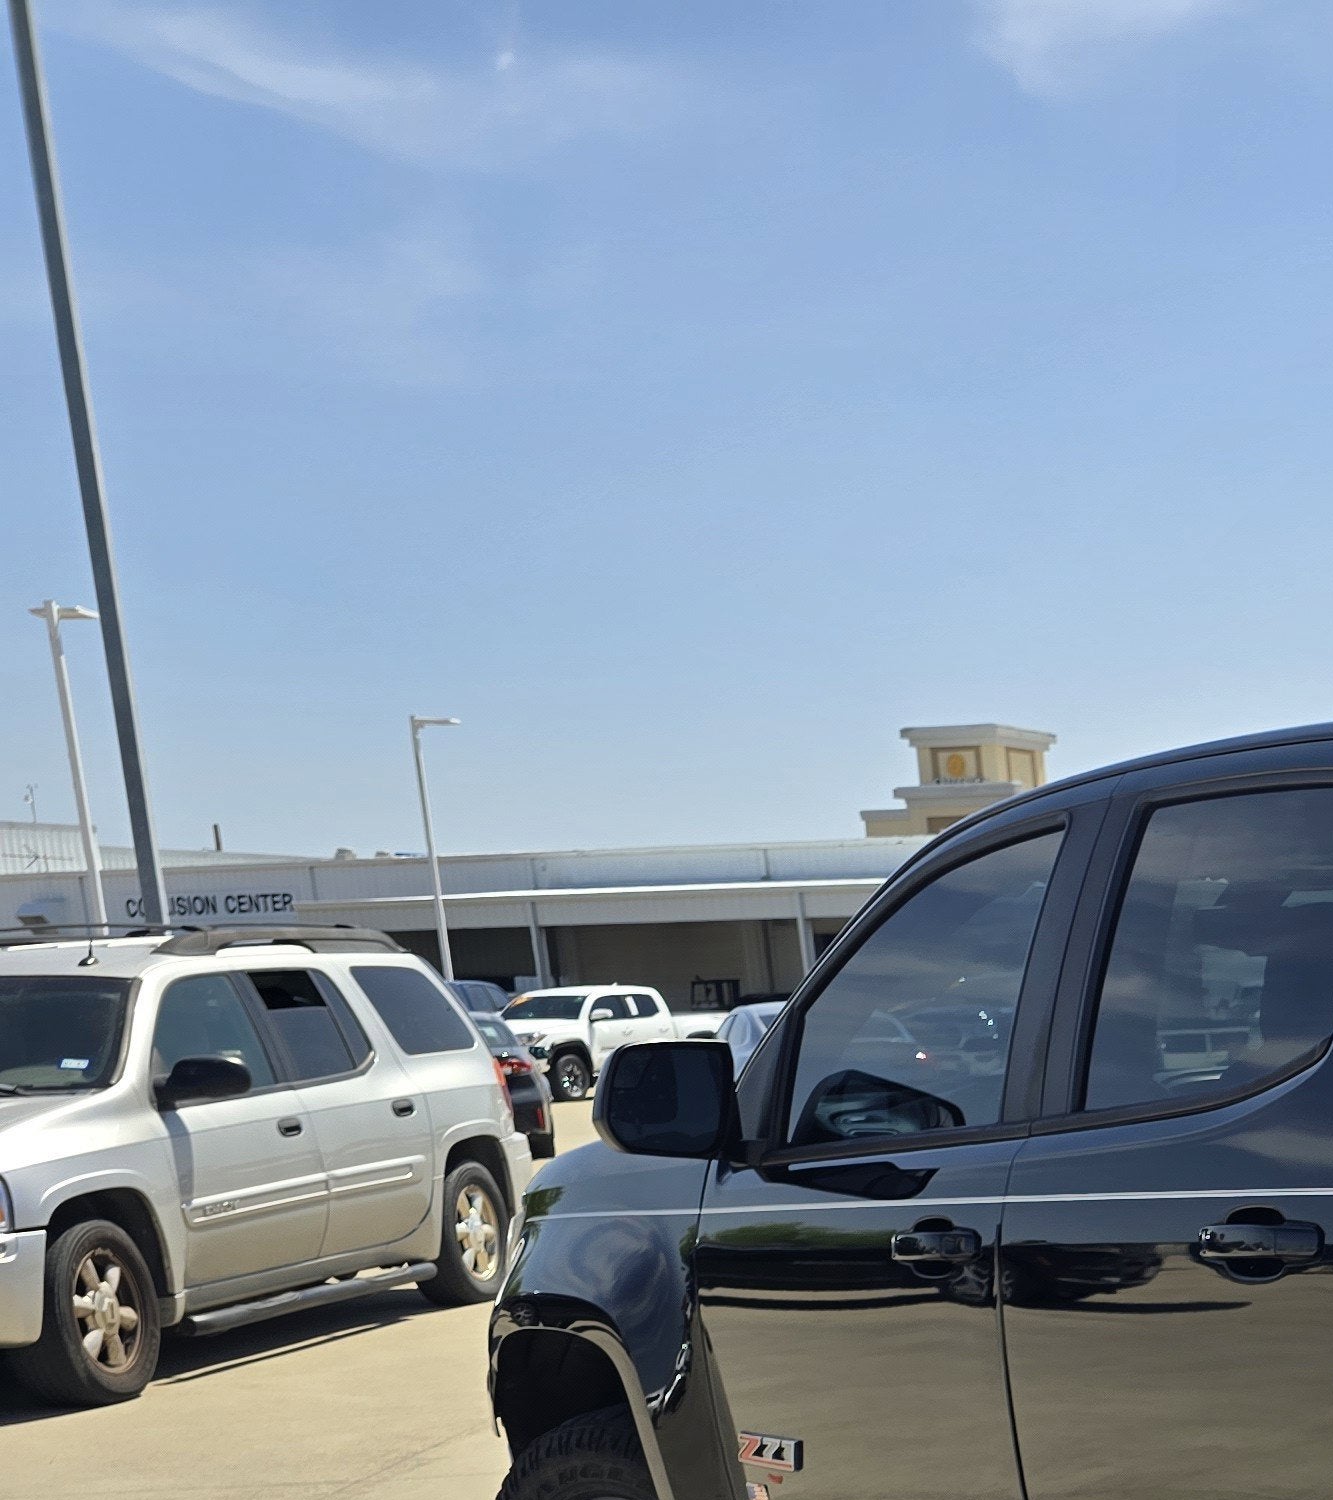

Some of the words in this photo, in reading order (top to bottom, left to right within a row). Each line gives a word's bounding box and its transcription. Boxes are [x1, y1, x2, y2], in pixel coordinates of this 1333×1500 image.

[126, 896, 218, 918] CISION
[225, 893, 294, 914] CENTER
[738, 1433, 797, 1471] Z71
